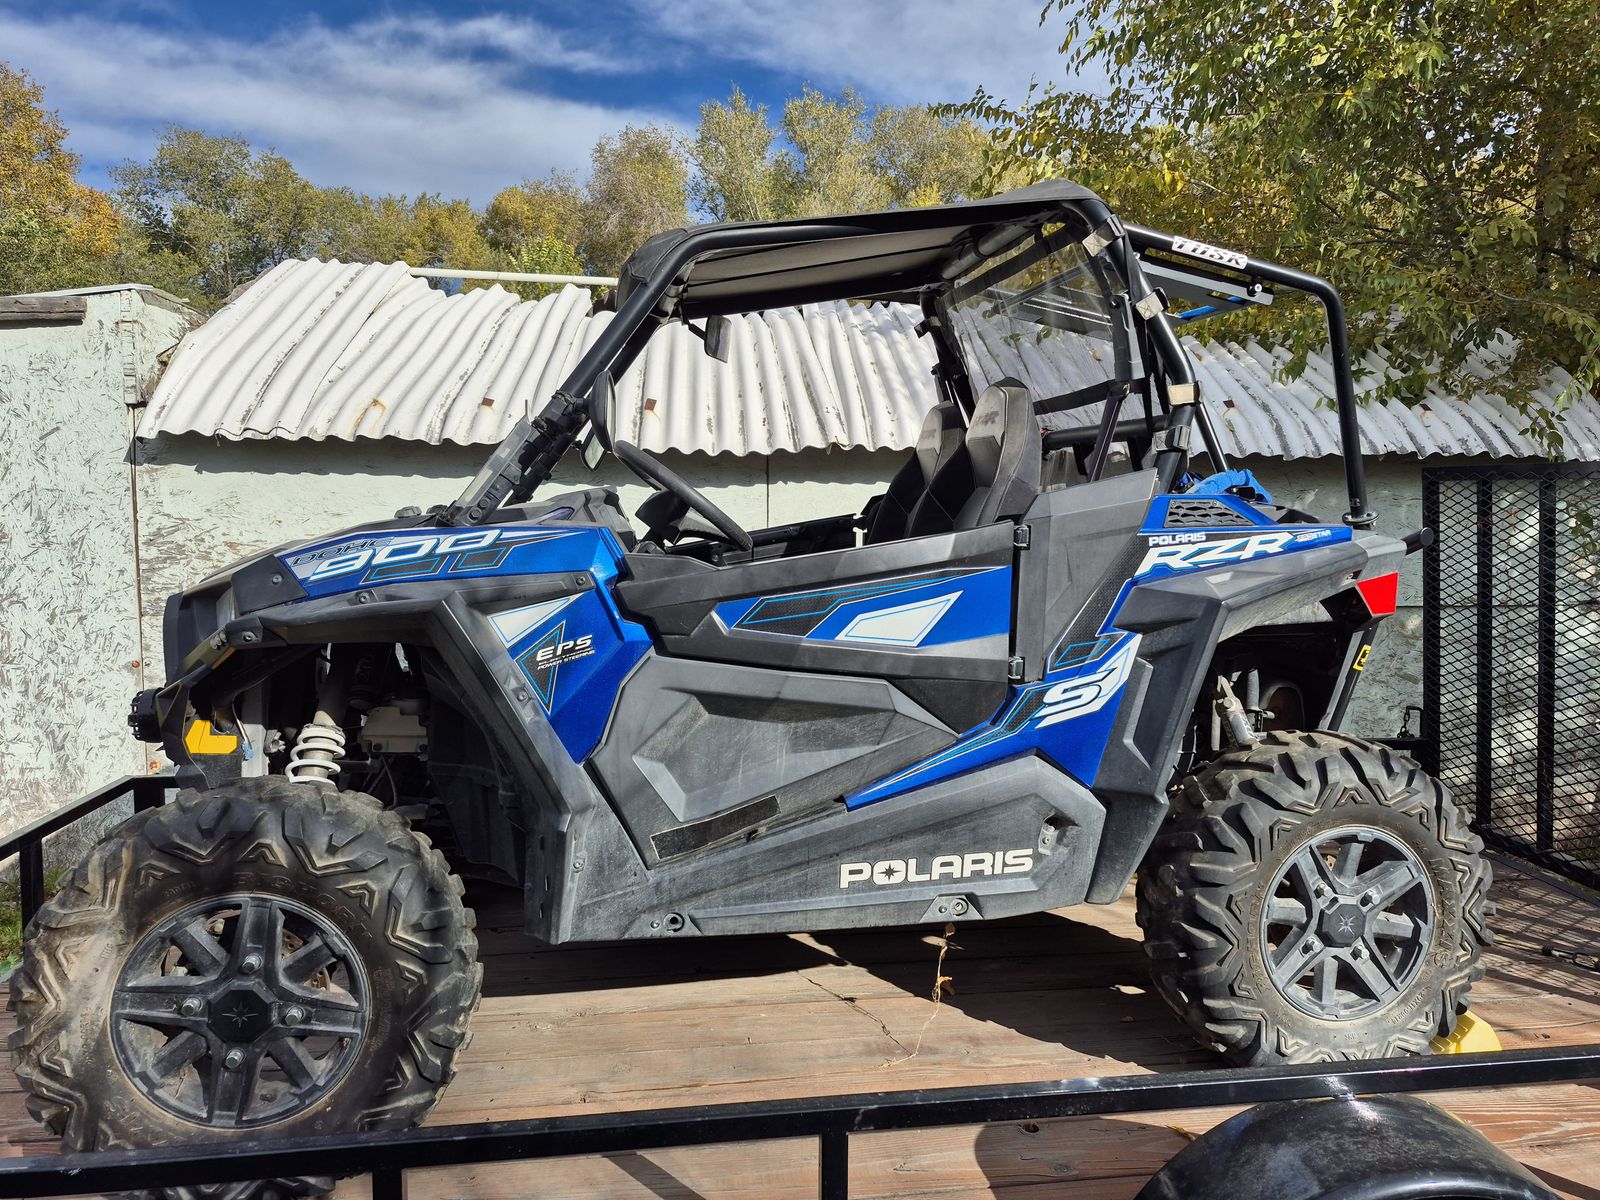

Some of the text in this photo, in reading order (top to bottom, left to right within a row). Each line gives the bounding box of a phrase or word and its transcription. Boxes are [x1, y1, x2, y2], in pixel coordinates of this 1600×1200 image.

[1173, 239, 1241, 266] TUSK
[291, 537, 394, 566] DOHC
[1148, 532, 1206, 547] POLARIS
[308, 528, 502, 581] 900
[1133, 532, 1293, 577] RZR
[536, 634, 593, 661] EPS
[839, 848, 1034, 889] POLARIS
